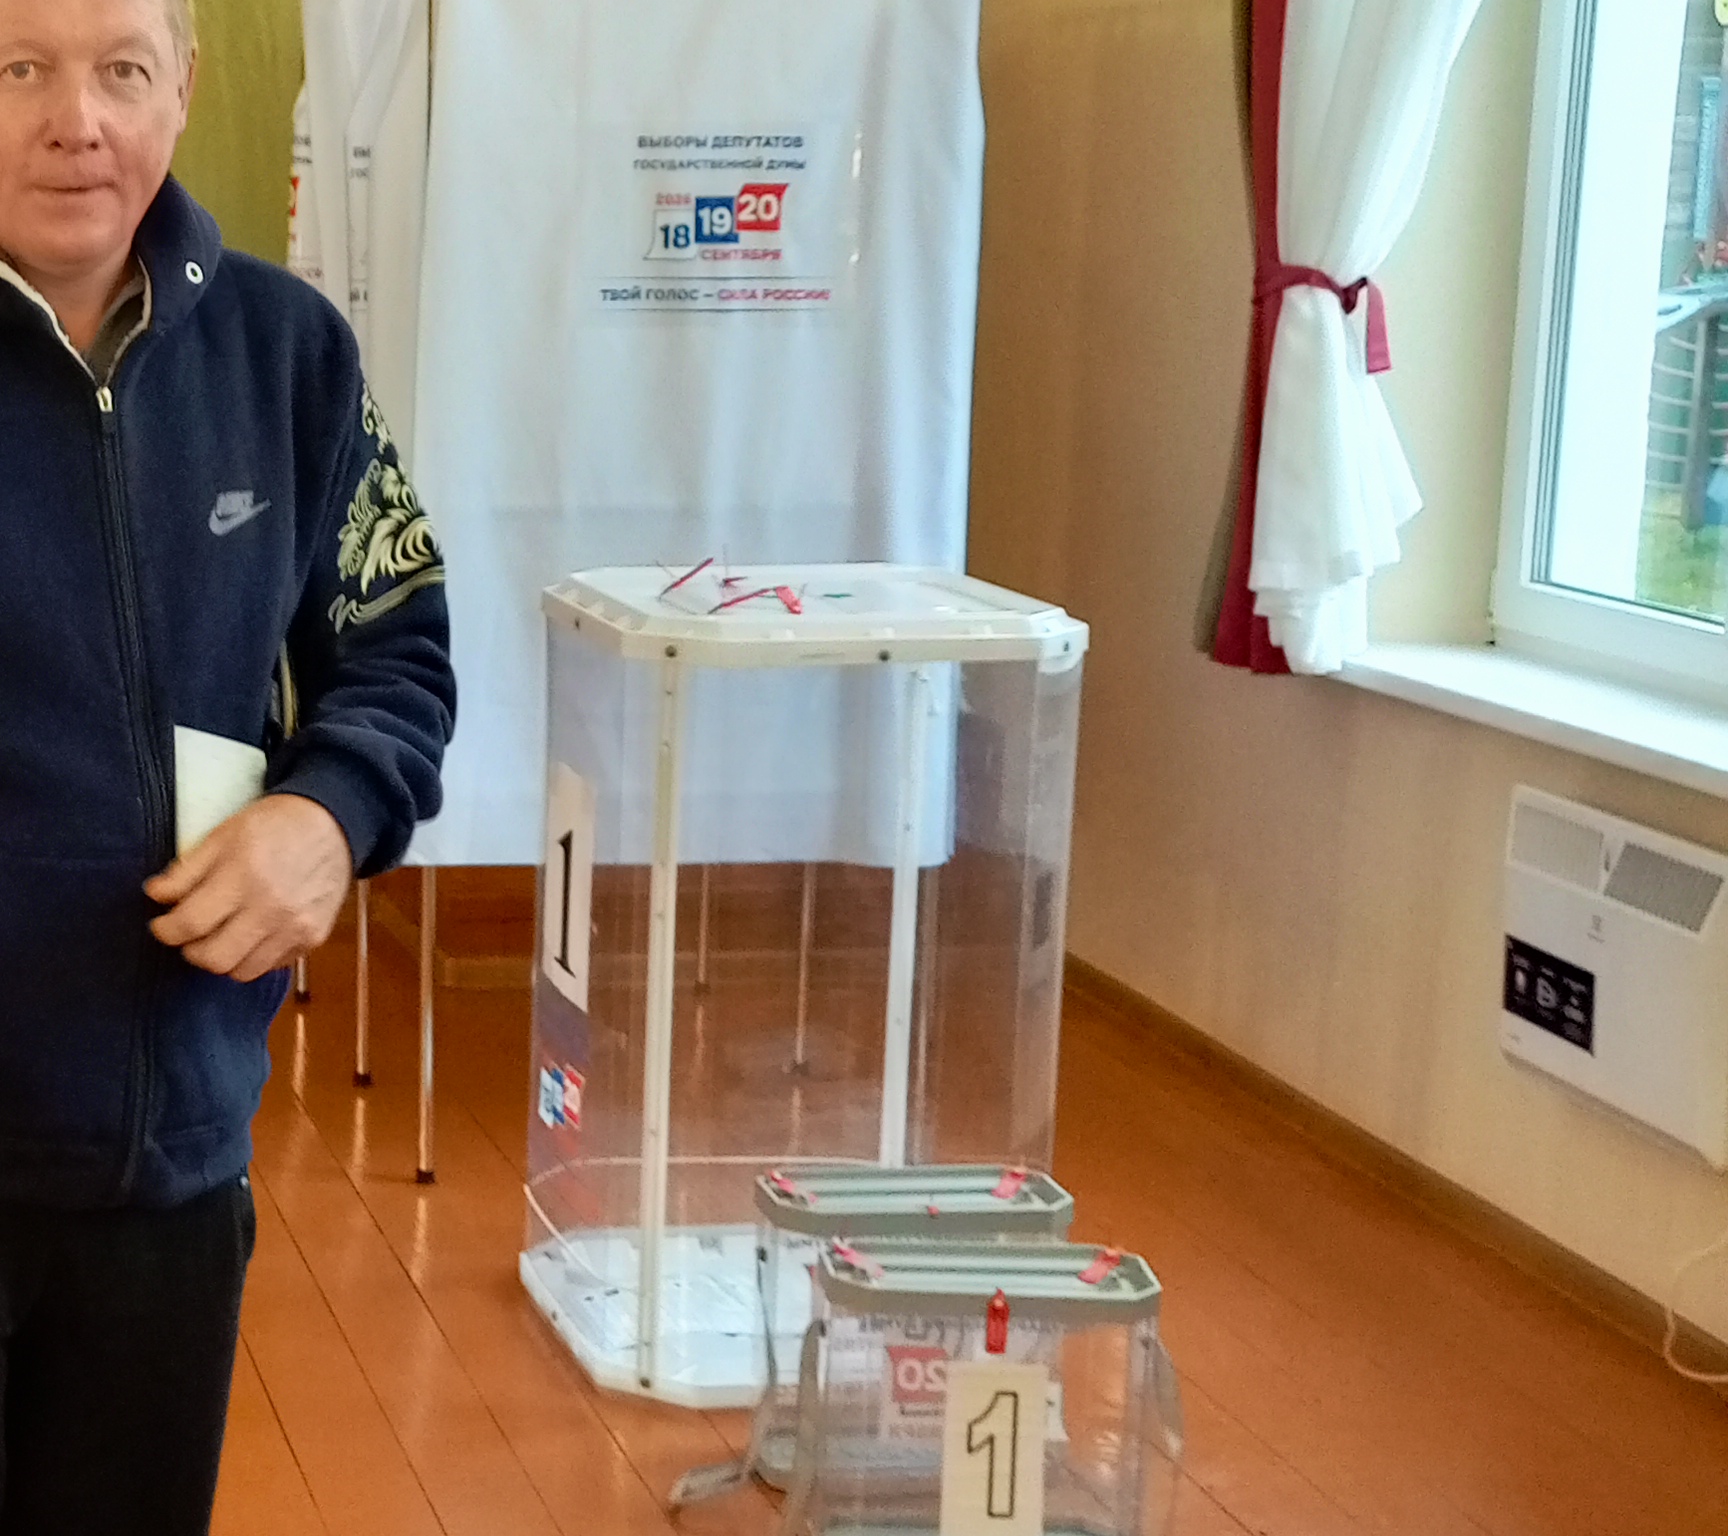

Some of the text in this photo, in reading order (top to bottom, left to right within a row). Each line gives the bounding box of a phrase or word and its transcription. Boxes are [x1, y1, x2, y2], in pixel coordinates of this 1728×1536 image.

[638, 135, 805, 149] ВЫБОРЫ ДЕПУТАТОВ
[660, 193, 779, 249] 18 19 20
[966, 1389, 1019, 1519] 1
